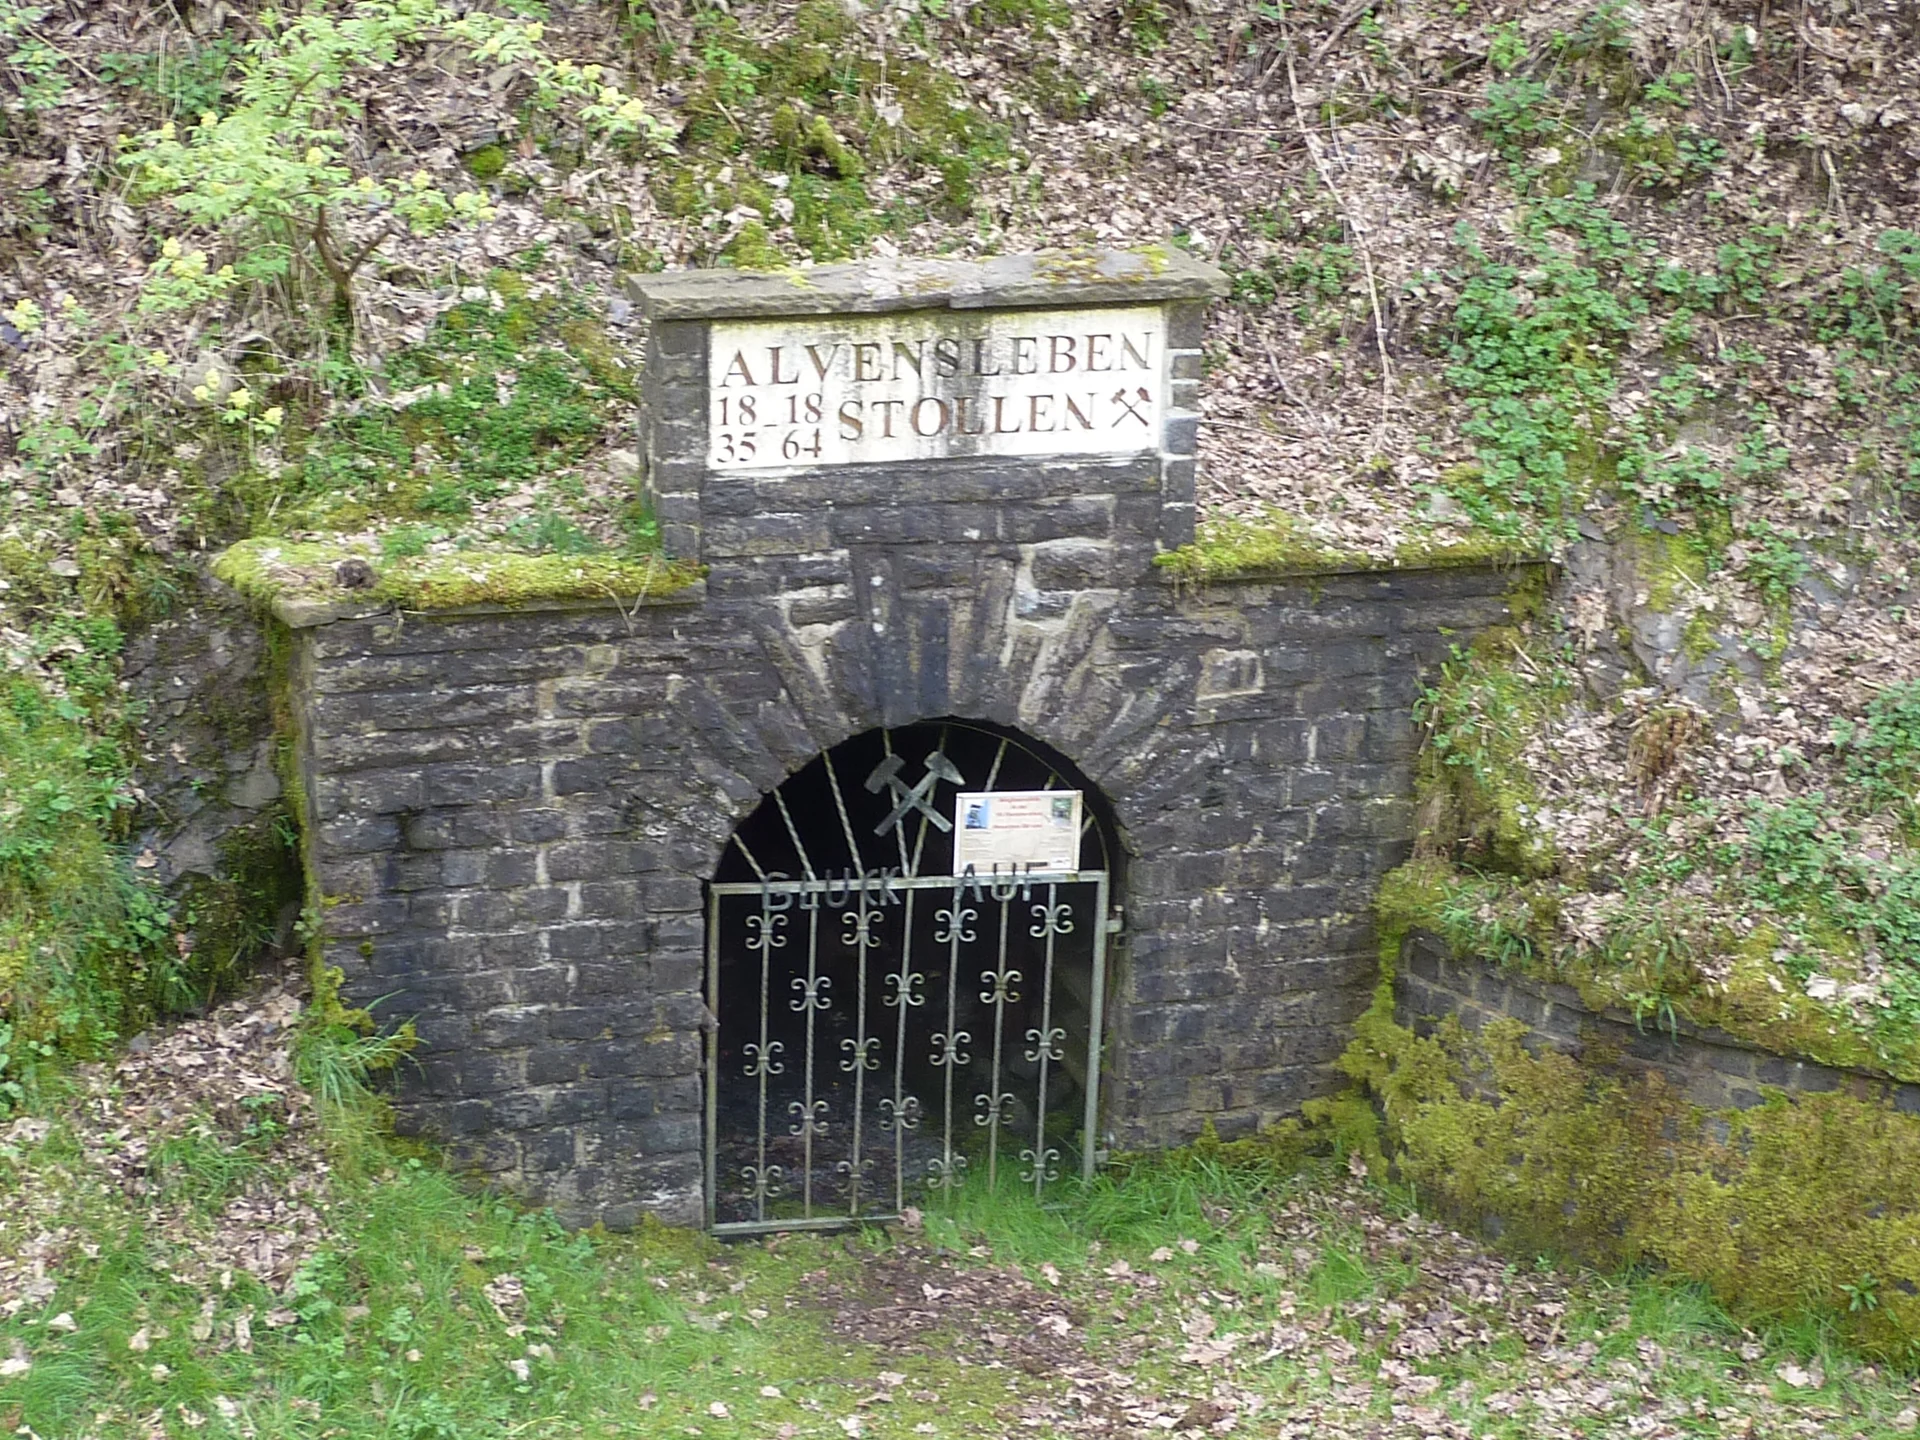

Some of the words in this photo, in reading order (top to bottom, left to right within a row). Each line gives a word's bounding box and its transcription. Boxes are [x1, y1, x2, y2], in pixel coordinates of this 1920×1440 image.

[718, 331, 1154, 388] ALVENSLEBEN
[717, 395, 757, 426] 18
[788, 393, 824, 424] 18
[838, 392, 1097, 441] STOLLEN
[716, 432, 756, 463] 35
[782, 429, 824, 459] 64
[953, 862, 1048, 903] AUF
